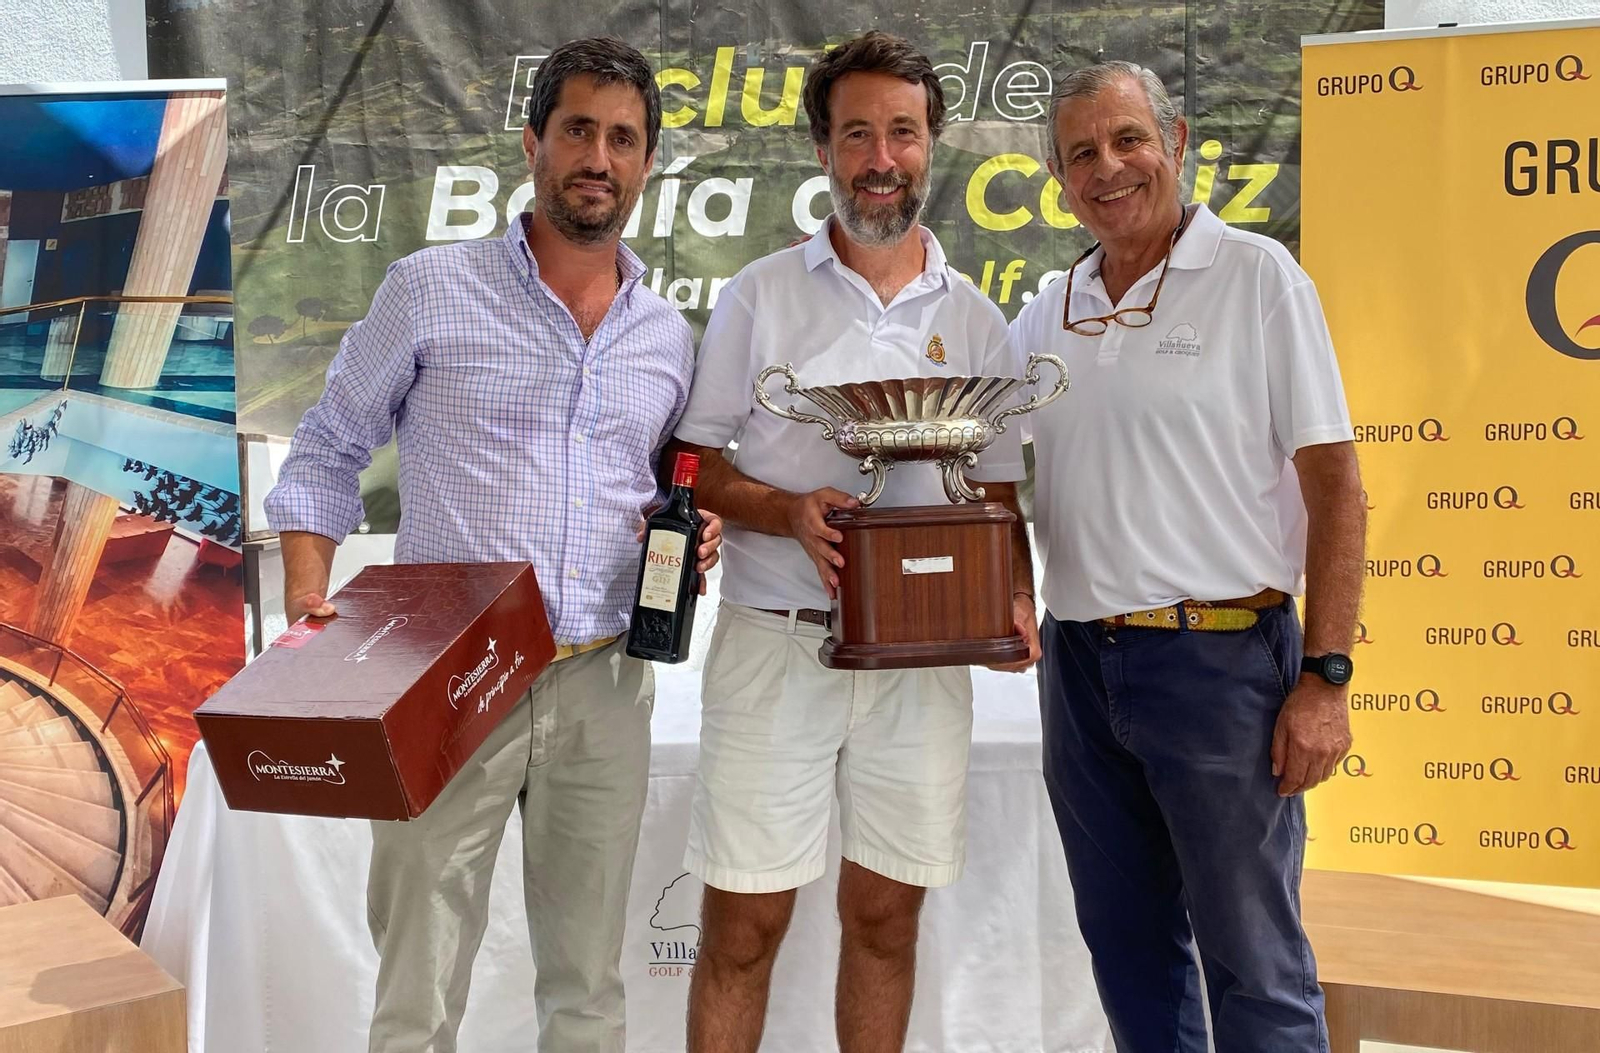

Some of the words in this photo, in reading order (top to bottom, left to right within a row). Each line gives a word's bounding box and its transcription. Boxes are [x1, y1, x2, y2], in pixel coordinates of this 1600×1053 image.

[1317, 73, 1383, 97] GRUPO
[1388, 65, 1425, 92] Q
[1480, 62, 1550, 87] GRUPO
[1555, 54, 1593, 82] Q
[654, 44, 839, 128] clu
[932, 41, 1053, 121] de
[286, 164, 386, 243] la
[425, 156, 754, 241] Bía
[966, 139, 1280, 231] Ciz
[1353, 424, 1413, 443] GRUPO
[1418, 418, 1451, 442] Q
[1485, 422, 1547, 442] GRUPO
[1552, 416, 1586, 441] Q
[1427, 491, 1489, 510] GRUPO
[1493, 485, 1526, 510] Q
[647, 550, 681, 568] RIVES
[1365, 559, 1412, 578] RUPO
[1416, 554, 1449, 578] Q
[1483, 560, 1545, 579] GRUPO
[1550, 554, 1584, 579] Q
[1425, 627, 1487, 646] GRUPO
[1491, 622, 1524, 646] Q
[1567, 629, 1600, 648] GRU
[452, 652, 495, 702] MONTESIERRA
[1351, 693, 1411, 712] GRUPO
[1415, 689, 1447, 713] Q
[1481, 696, 1543, 715] GRUPO
[1547, 691, 1581, 716] Q
[255, 764, 336, 776] MONTESIERRA
[1342, 754, 1373, 778] Q
[1424, 761, 1485, 781] GRUPO
[1489, 757, 1522, 782] Q
[1564, 765, 1600, 784] GRU
[1349, 826, 1409, 845] GRUPO
[1413, 822, 1446, 847] Q
[1479, 830, 1540, 850] GRUPO
[1545, 826, 1578, 851] Q
[650, 941, 697, 960] Villa
[648, 966, 684, 977] GOLF
